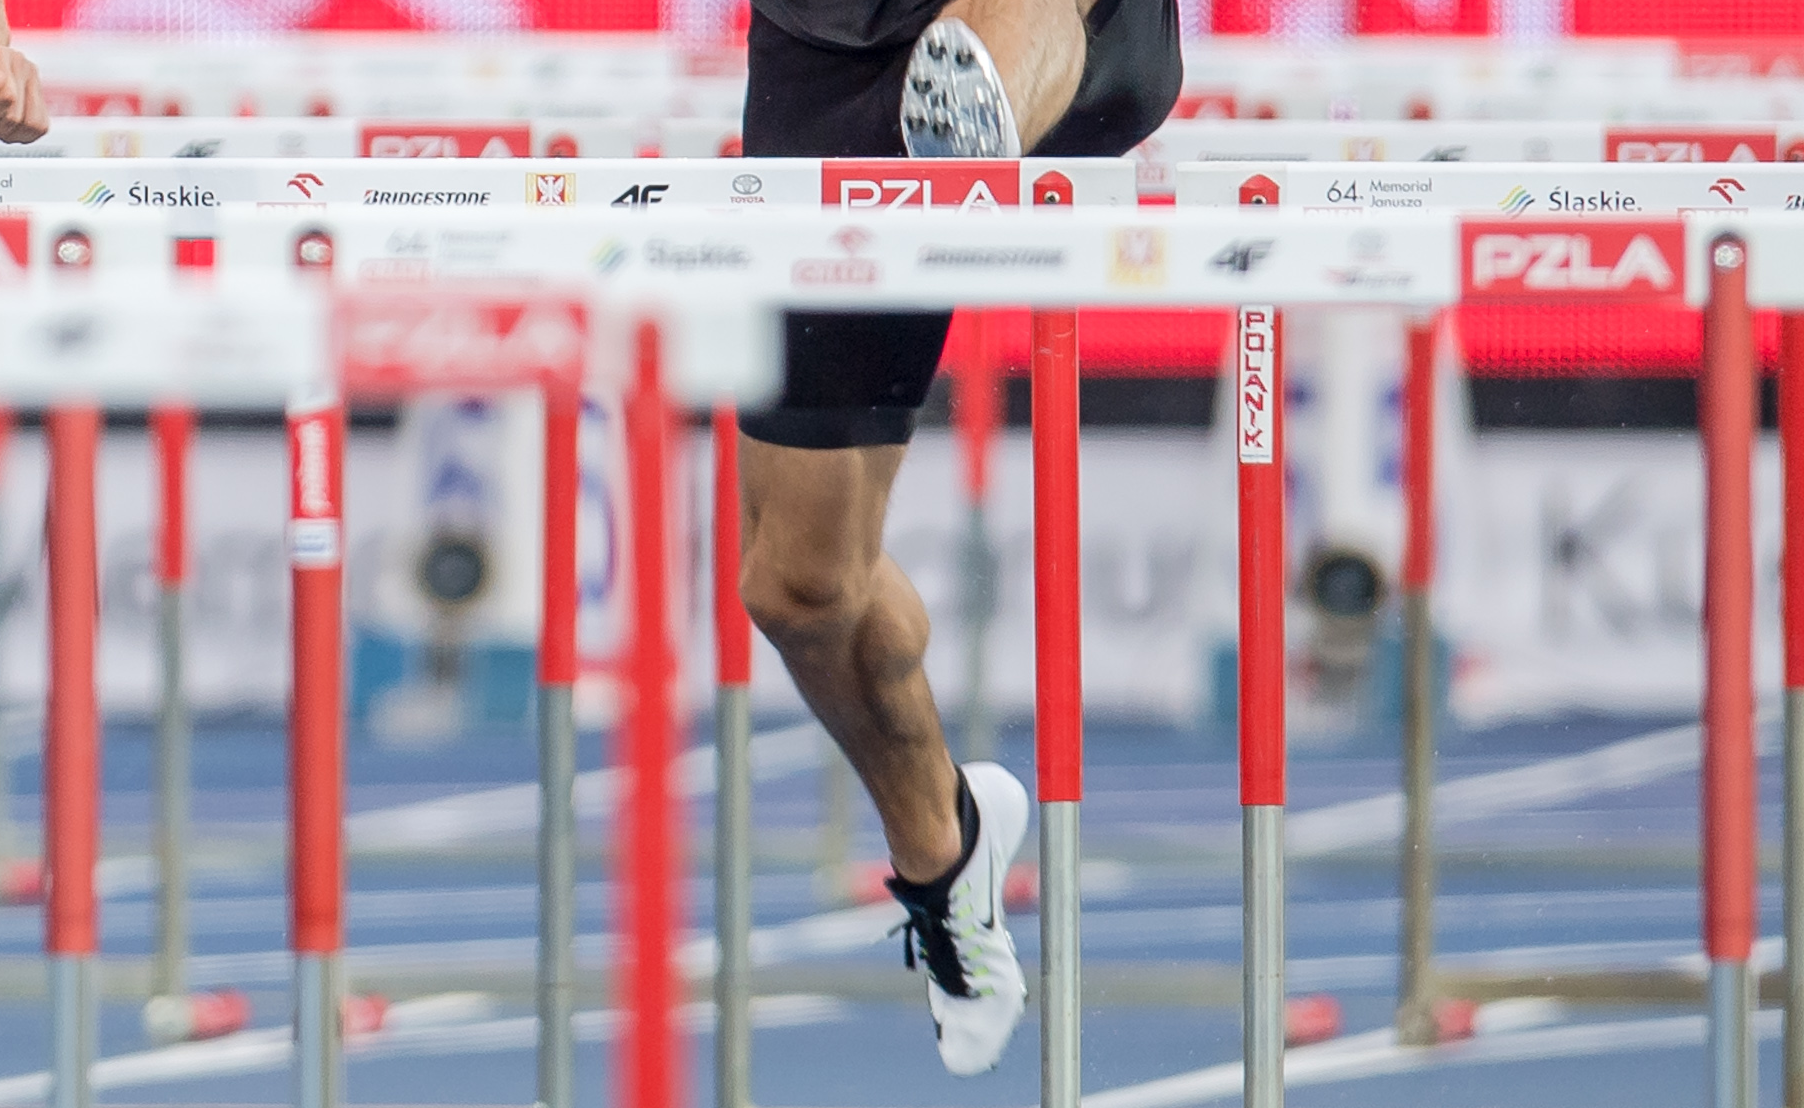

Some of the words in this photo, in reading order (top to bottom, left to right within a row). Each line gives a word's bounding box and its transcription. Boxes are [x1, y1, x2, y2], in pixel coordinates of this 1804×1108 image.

[364, 189, 491, 206] BRIDGESTONE
[840, 180, 1002, 214] PZLA
[1327, 180, 1364, 203] 64.
[1369, 195, 1422, 208] Janusza
[1548, 187, 1643, 217] Śląskie.
[1470, 233, 1675, 291] PZLA
[1245, 312, 1267, 448] POLANIK
